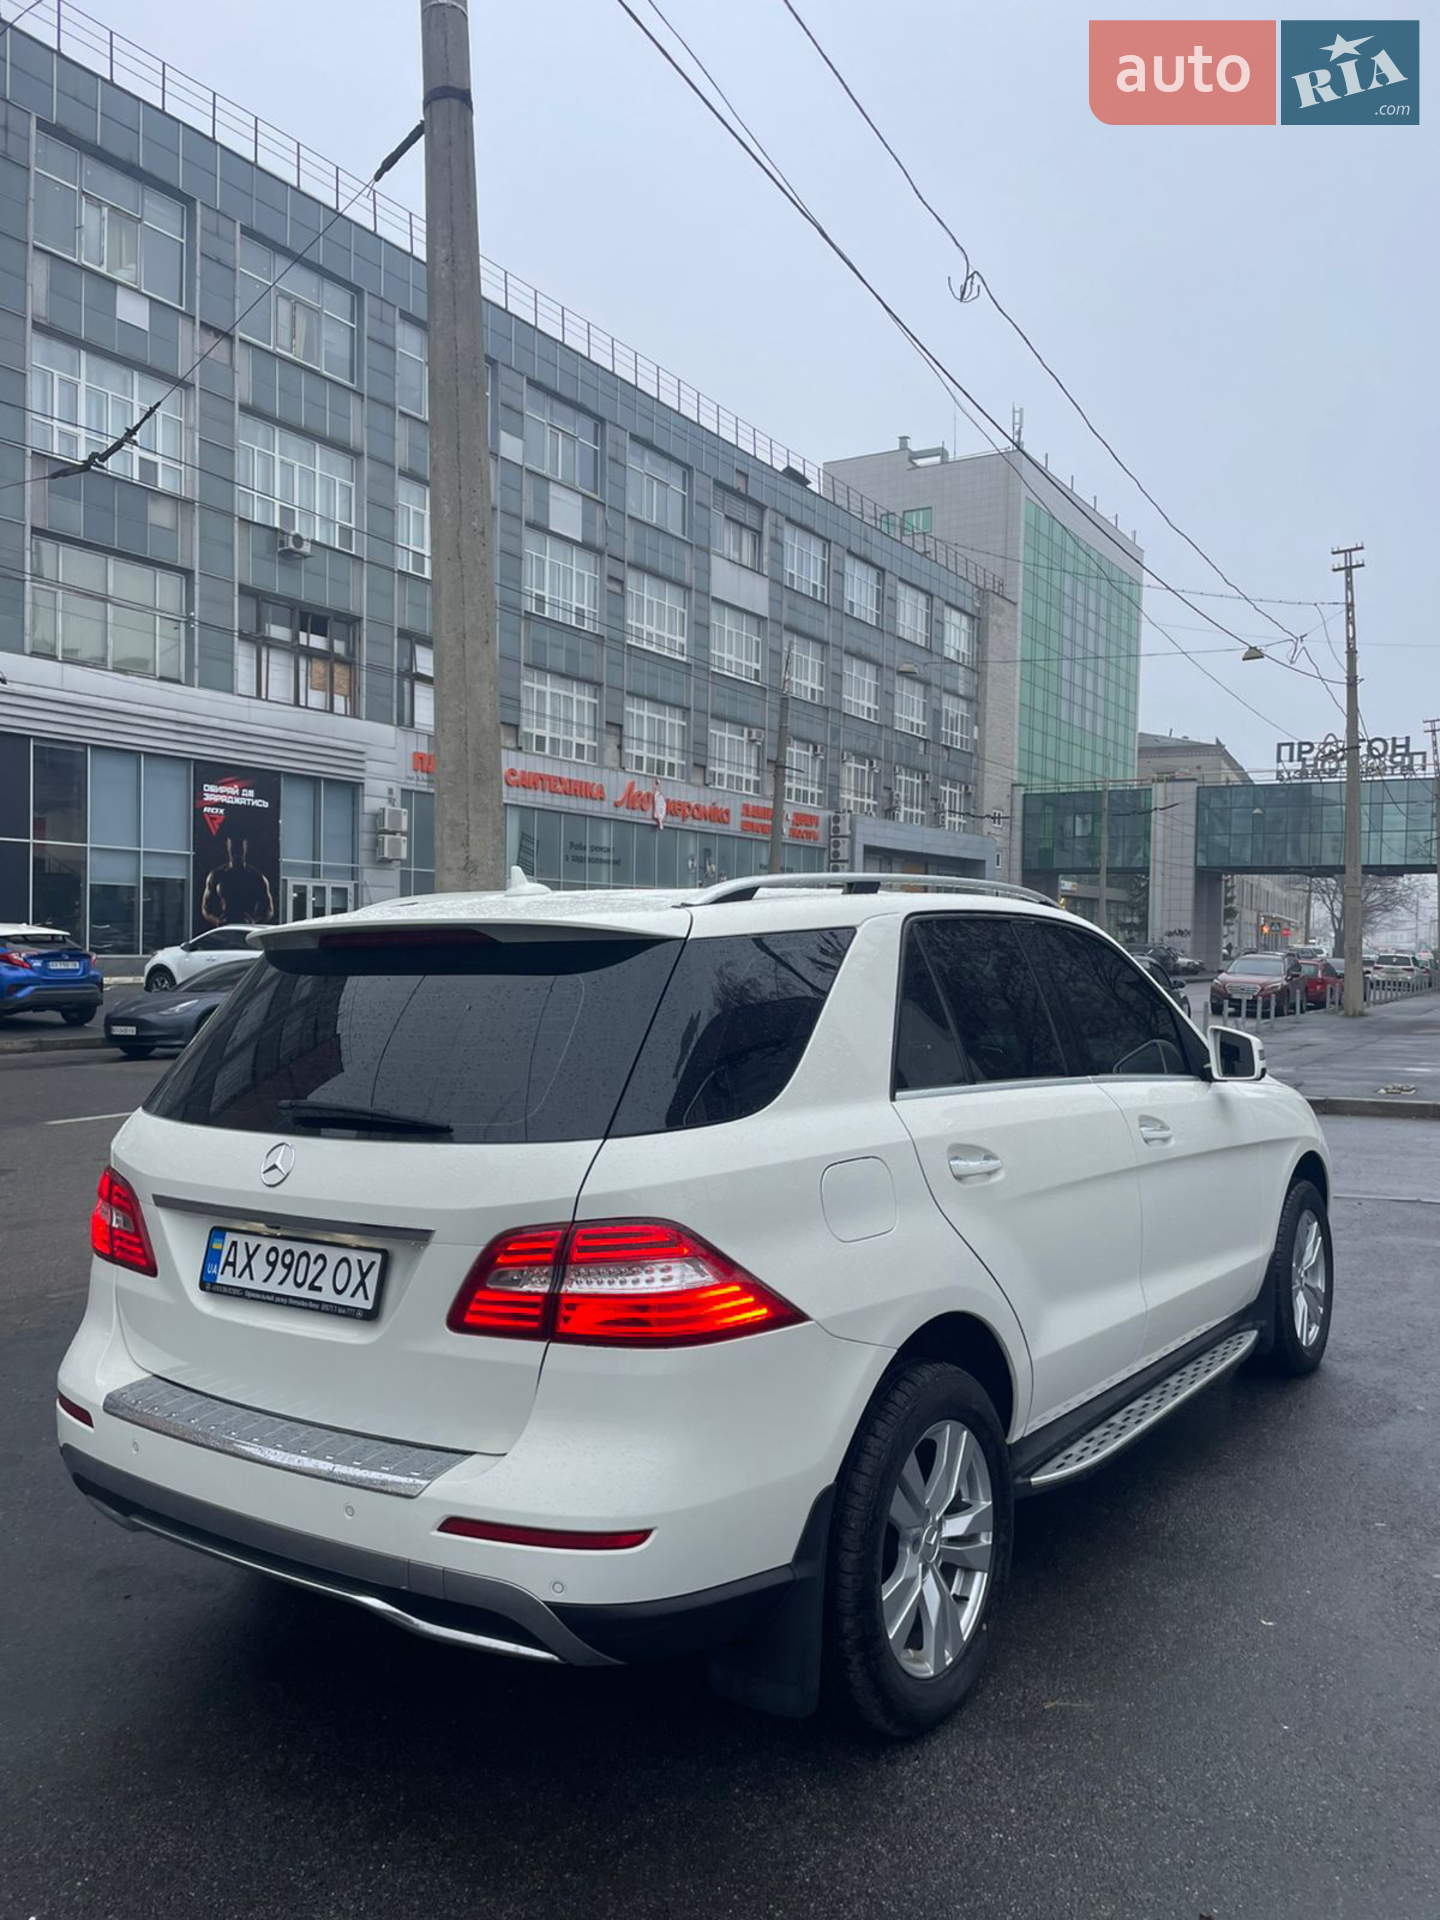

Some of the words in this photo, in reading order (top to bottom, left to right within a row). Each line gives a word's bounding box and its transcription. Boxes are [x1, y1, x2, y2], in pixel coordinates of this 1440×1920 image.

[504, 767, 606, 801] САНТЕХНІКА
[207, 1262, 218, 1274] UA
[220, 1240, 262, 1281] AX
[262, 1246, 328, 1293] 9902
[332, 1256, 377, 1301] OX
